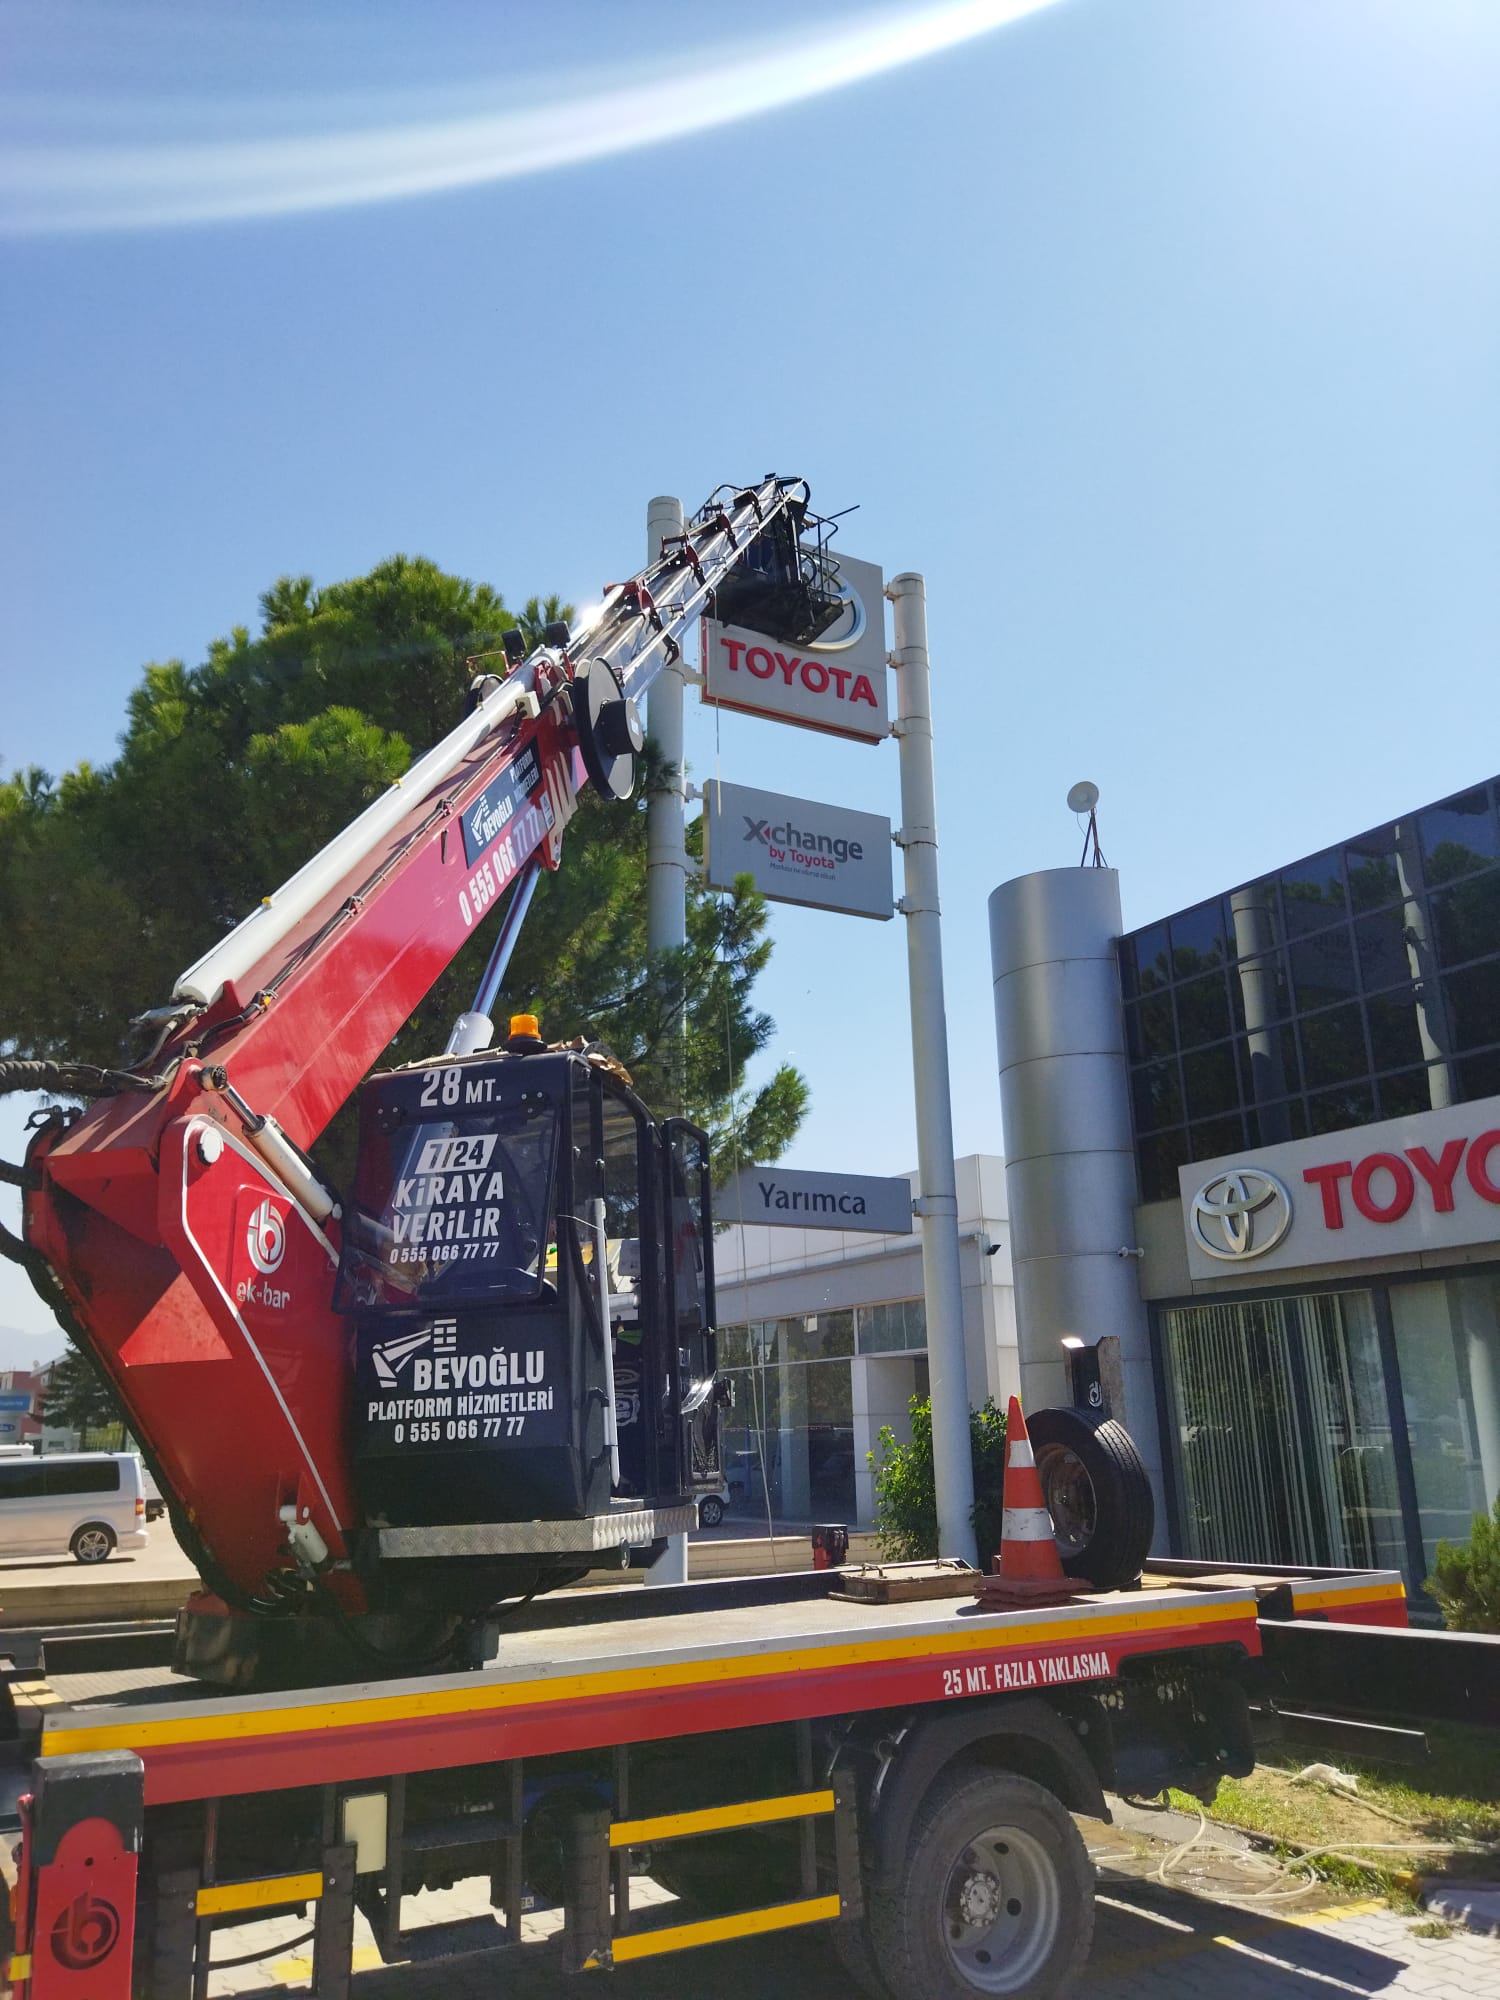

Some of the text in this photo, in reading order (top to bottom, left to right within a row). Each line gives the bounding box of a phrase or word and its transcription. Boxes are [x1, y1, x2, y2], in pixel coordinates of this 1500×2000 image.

[720, 637, 878, 708] TOYOTA
[742, 815, 863, 864] Xchange
[769, 845, 836, 870] by Toyota
[458, 805, 541, 927] 0 555 066 77 77
[420, 1068, 503, 1108] 28 MT.
[428, 1139, 485, 1168] 7/24
[398, 1171, 504, 1208] KİRAYA
[758, 1182, 867, 1216] Yarımca
[393, 1207, 500, 1244] VERİLİR
[389, 1241, 500, 1264] 0 555 066 77 77
[236, 1277, 291, 1309] ek-bar
[413, 1346, 545, 1392] BEYOĞLU
[368, 1386, 554, 1422] PLATFORM HİZMETLERİ
[394, 1415, 525, 1443] 0 555 066 77 77
[943, 1651, 1111, 1696] 25 MT. FAZLA YAKLASMA
